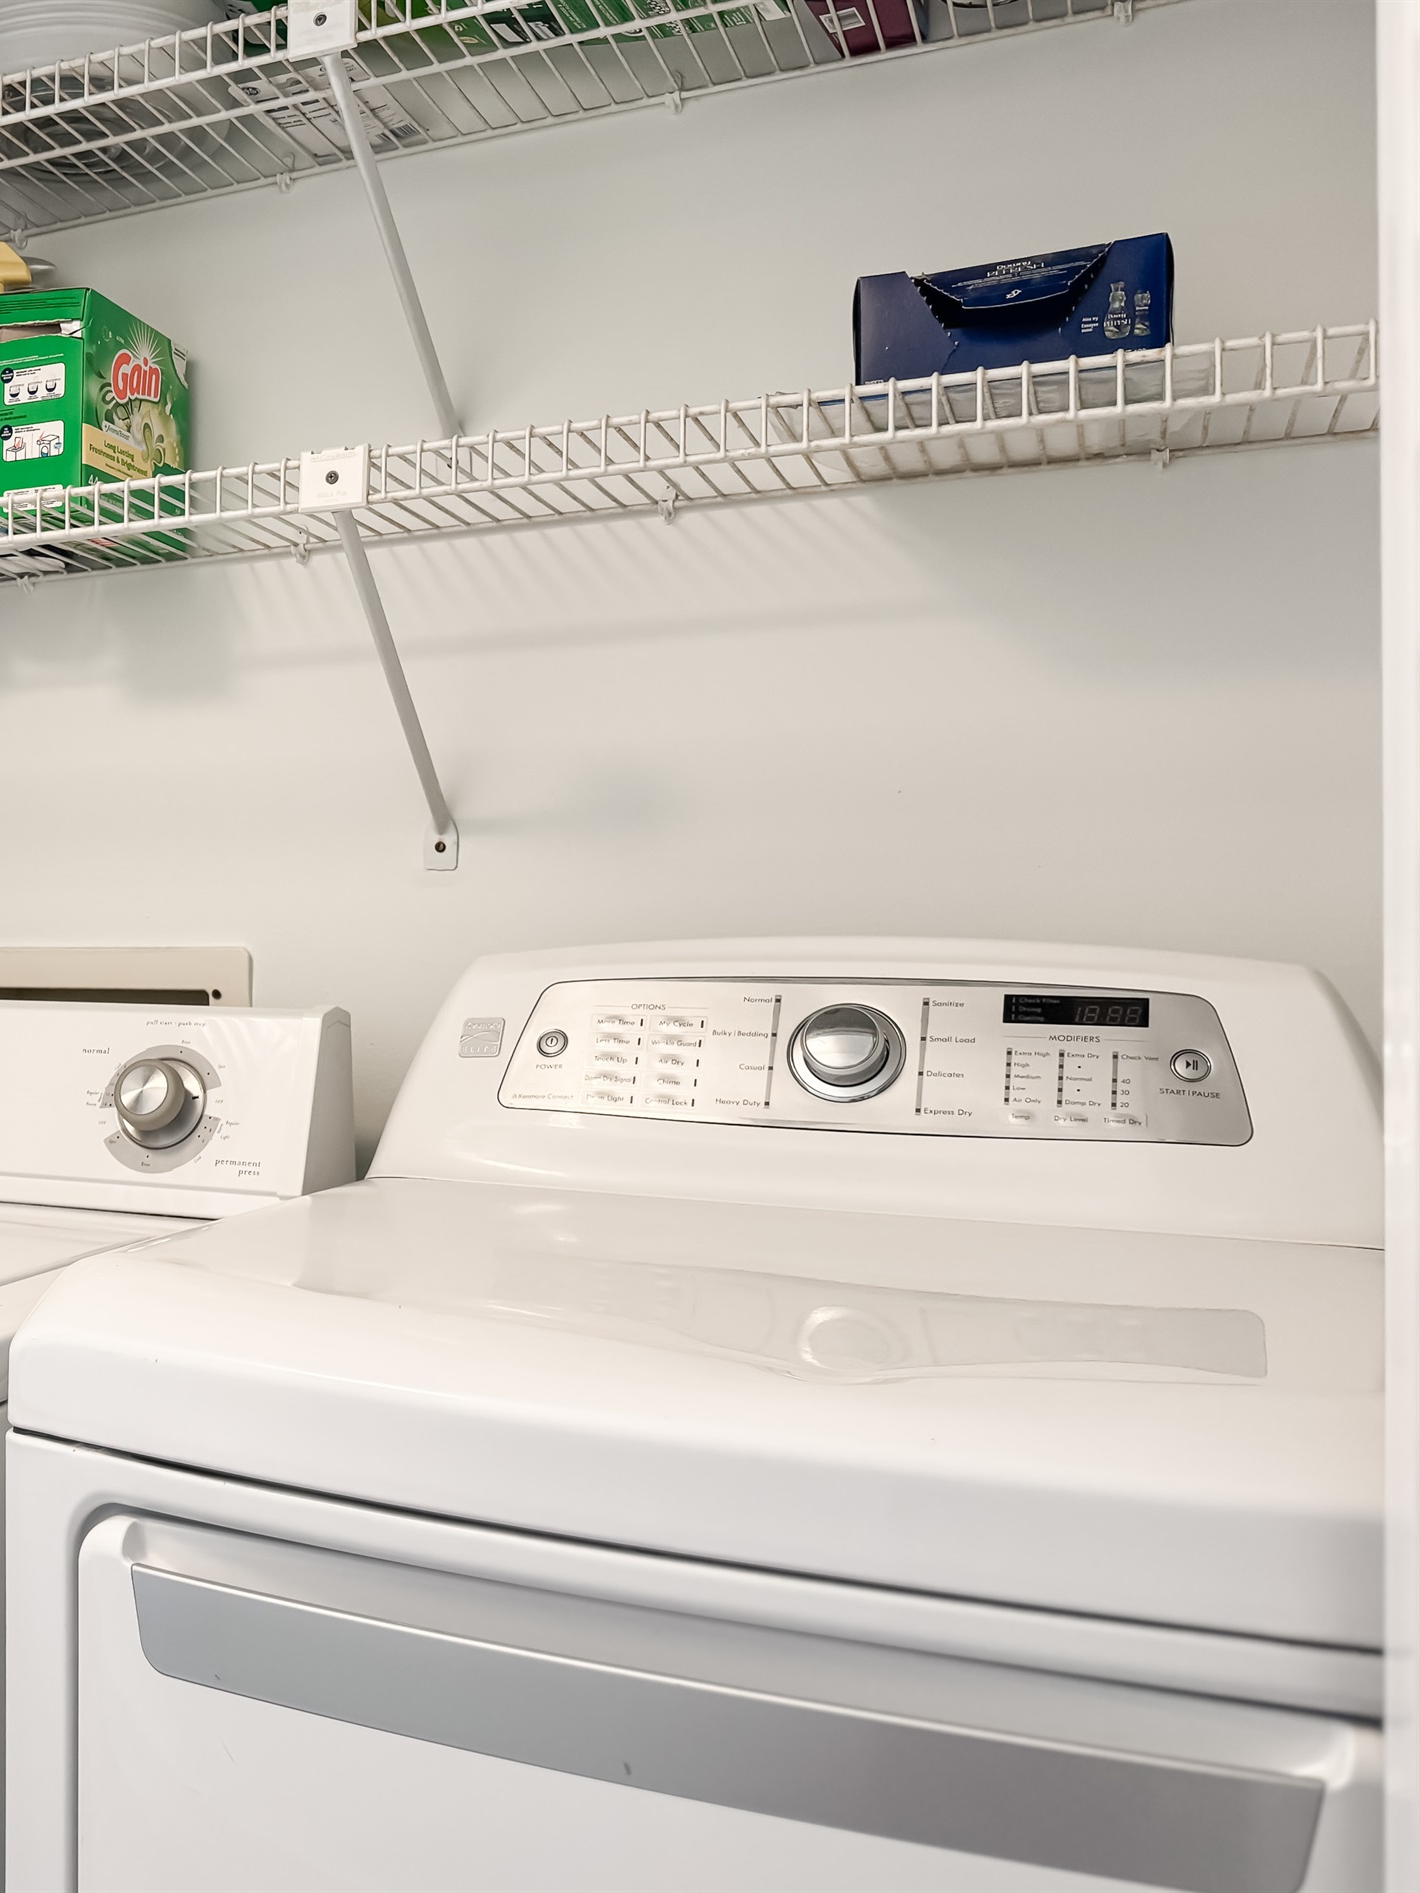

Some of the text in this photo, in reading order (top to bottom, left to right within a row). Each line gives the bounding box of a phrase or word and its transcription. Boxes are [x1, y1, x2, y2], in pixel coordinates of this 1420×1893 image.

[112, 351, 161, 402] Gain
[89, 444, 115, 462] Freshness
[104, 440, 134, 462] Long Lasting
[932, 1000, 965, 1008] Sanitize
[672, 1020, 694, 1028] Cycle
[955, 1036, 976, 1044] Load
[1049, 1035, 1101, 1043] MODIFIERS
[82, 1047, 110, 1055] normal
[616, 1056, 628, 1064] Up
[1121, 1053, 1142, 1061] Check
[671, 1058, 684, 1066] Dry
[739, 1063, 765, 1071] Casual
[926, 1070, 964, 1078] Delicates
[657, 1078, 681, 1086] Chime
[607, 1094, 625, 1102] Light
[671, 1098, 688, 1106] Lock
[715, 1098, 761, 1107] Heavy Duty
[924, 1108, 973, 1117] Express Dry
[1128, 1118, 1142, 1126] Dry
[214, 1158, 261, 1168] permanent
[238, 1168, 261, 1177] press
